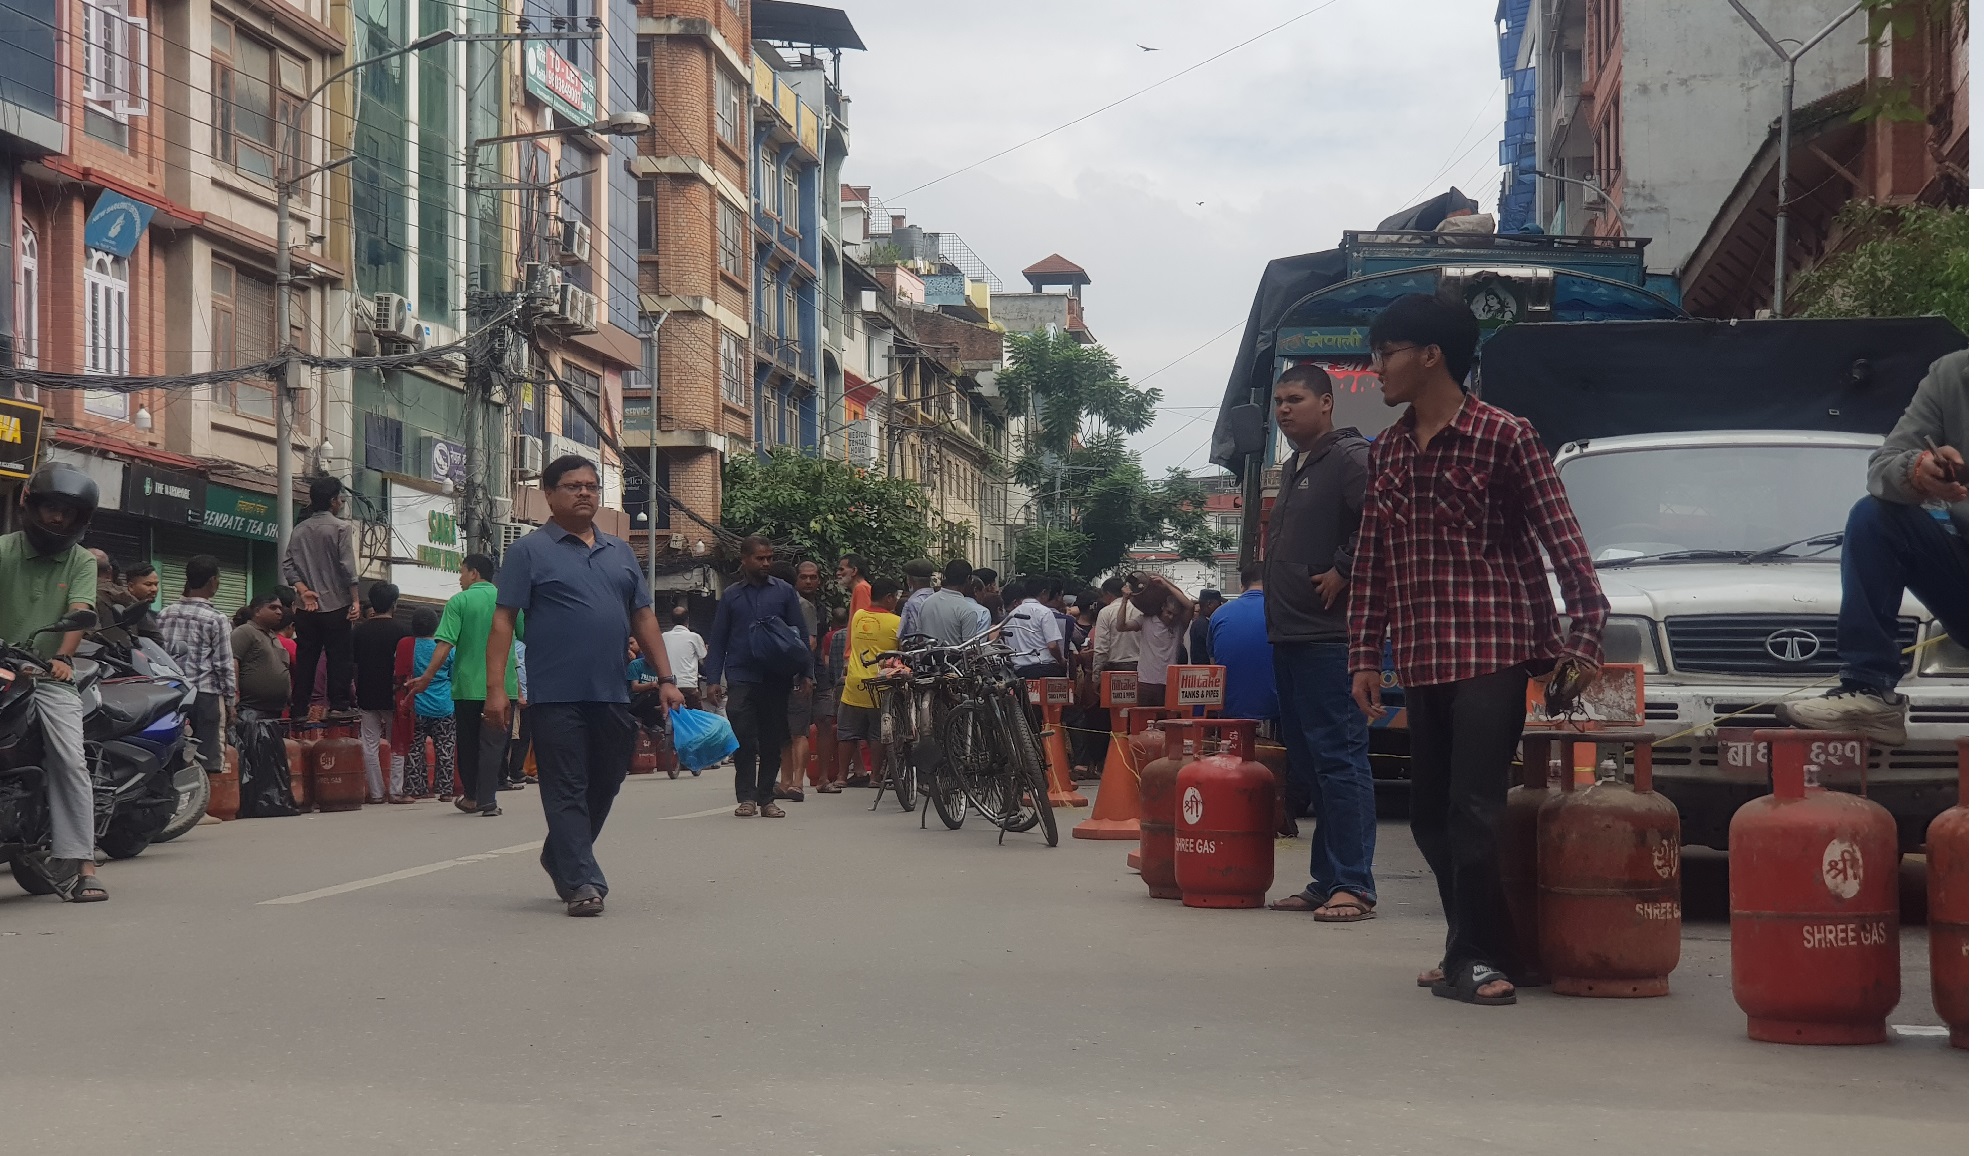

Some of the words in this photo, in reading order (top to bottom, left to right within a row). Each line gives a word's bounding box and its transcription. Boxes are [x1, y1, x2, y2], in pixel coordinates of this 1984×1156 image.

[246, 519, 264, 536] TEA
[1181, 690, 1199, 699] TANKS
[1205, 689, 1220, 699] PIPES
[1196, 839, 1216, 854] GAS
[1635, 902, 1672, 920] SHREE
[1802, 923, 1858, 949] SHREE
[1860, 921, 1886, 945] GAS
